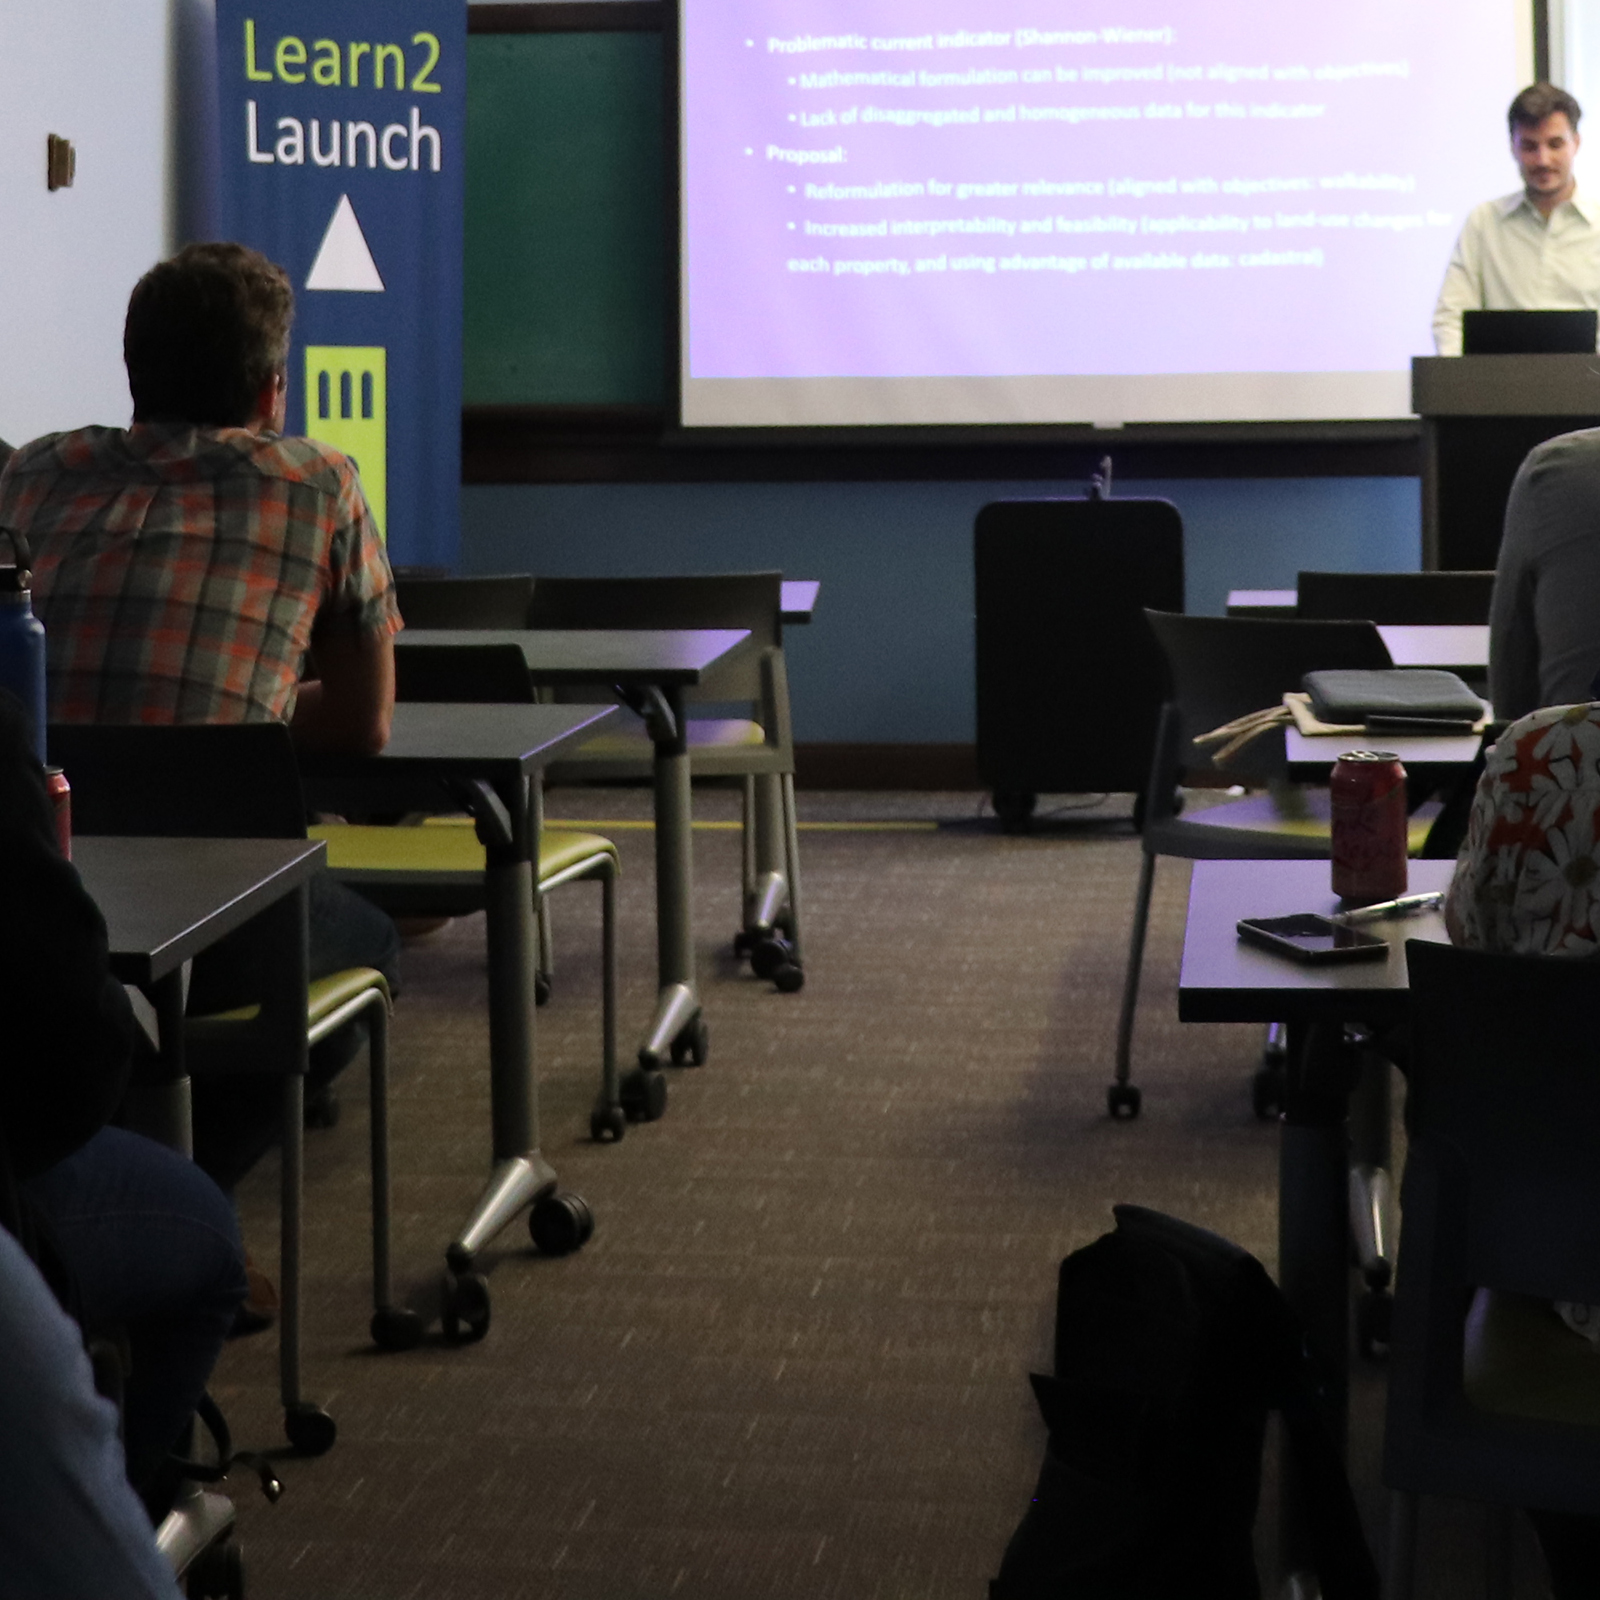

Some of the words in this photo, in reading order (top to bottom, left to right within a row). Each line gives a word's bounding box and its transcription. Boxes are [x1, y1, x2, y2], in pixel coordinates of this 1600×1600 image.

[767, 34, 867, 54] Problematic
[871, 33, 934, 51] current
[937, 29, 1011, 49] indicator
[1015, 25, 1177, 48] (Shannon-Wiener):
[243, 18, 442, 93] Learn2
[799, 69, 916, 90] Mathematical
[919, 67, 1019, 88] formulation
[1022, 68, 1052, 84] can
[1056, 65, 1078, 83] be
[1082, 63, 1163, 84] improved
[1167, 63, 1203, 83] (not
[1208, 62, 1269, 84] aligned
[800, 108, 837, 128] Lack
[840, 105, 859, 126] of
[861, 105, 980, 128] disaggregated
[983, 104, 1016, 123] and
[1144, 101, 1182, 120] data
[245, 99, 442, 172] Launch
[766, 143, 848, 166] Proposal:
[805, 180, 924, 201] Reformulation
[927, 177, 953, 197] for
[956, 181, 1018, 200] greater
[1022, 178, 1104, 197] relevance
[804, 219, 887, 238] Increased
[891, 216, 1015, 237] interpretability
[1020, 216, 1052, 234] and
[787, 256, 829, 273] each
[833, 257, 911, 277] property,
[915, 253, 947, 273] and
[950, 254, 996, 274] using
[999, 253, 1087, 274] advantage
[1090, 251, 1109, 271] of
